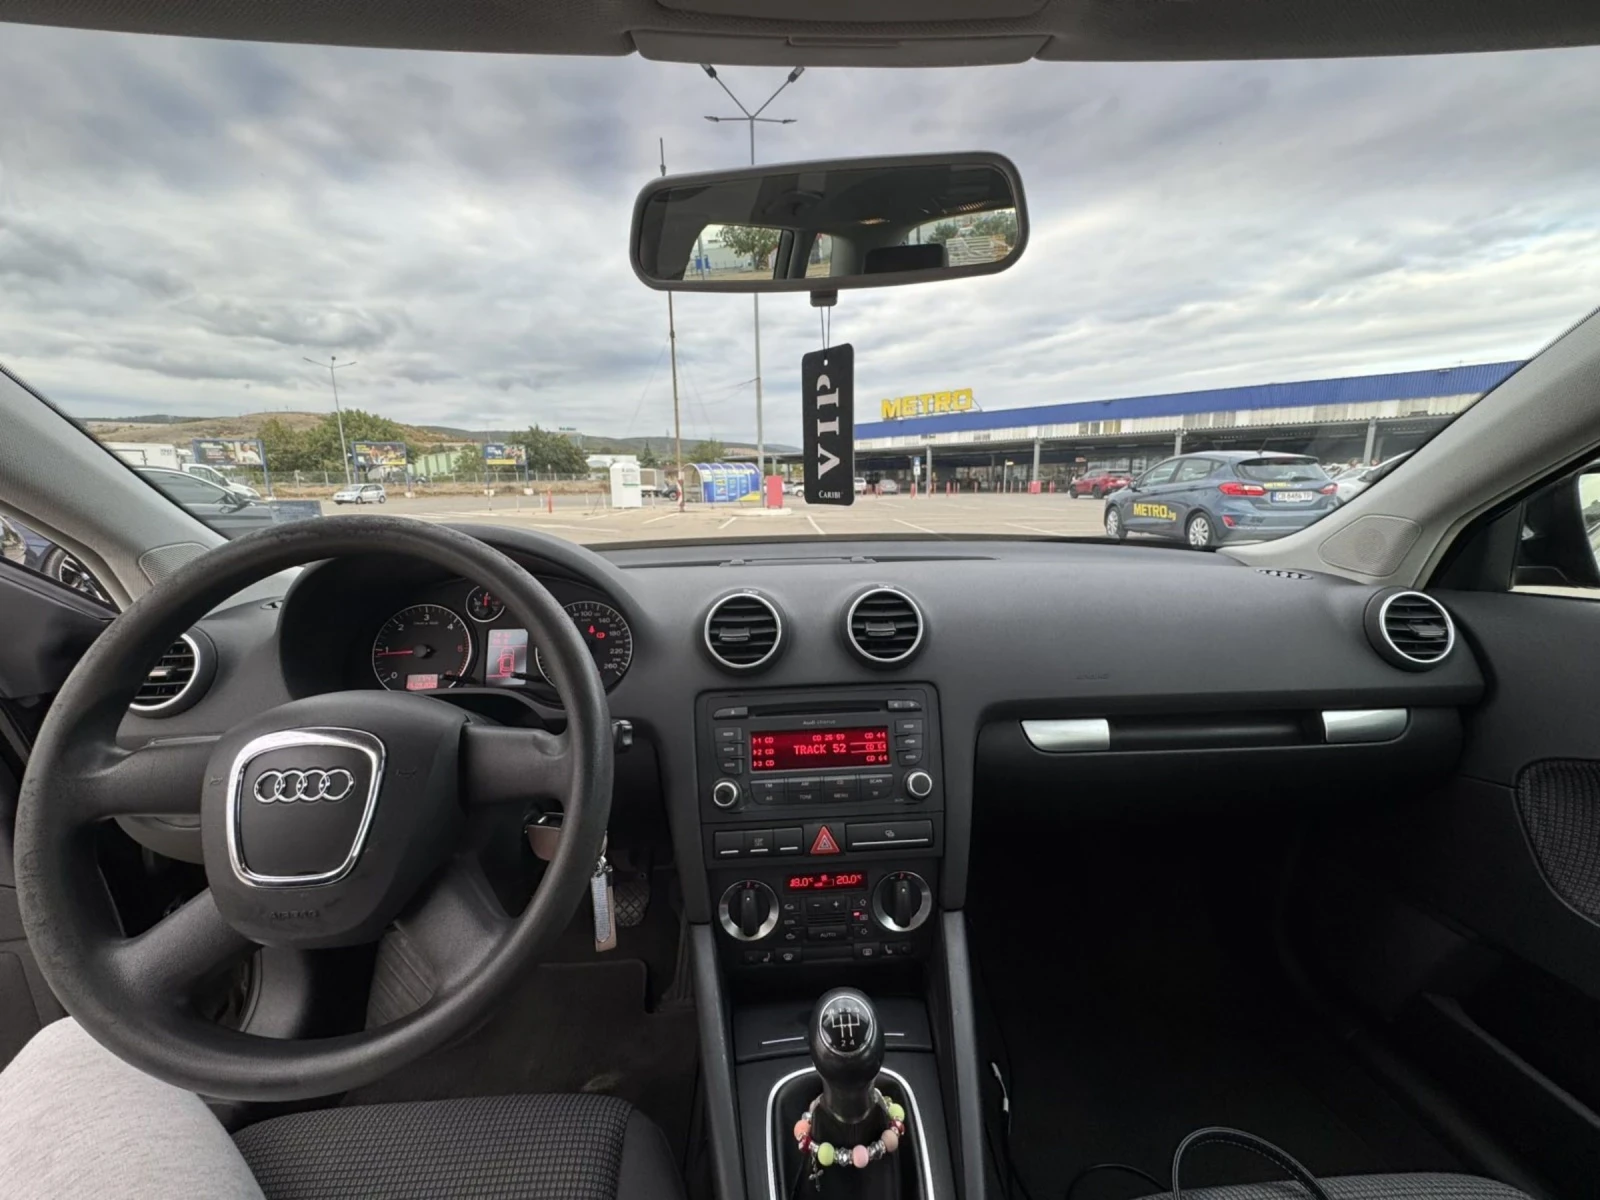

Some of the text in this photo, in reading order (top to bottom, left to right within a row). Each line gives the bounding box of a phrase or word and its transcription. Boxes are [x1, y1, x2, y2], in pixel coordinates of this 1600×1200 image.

[881, 388, 973, 419] METRO
[816, 374, 841, 480] VIP
[793, 743, 847, 755] TRACK 52
